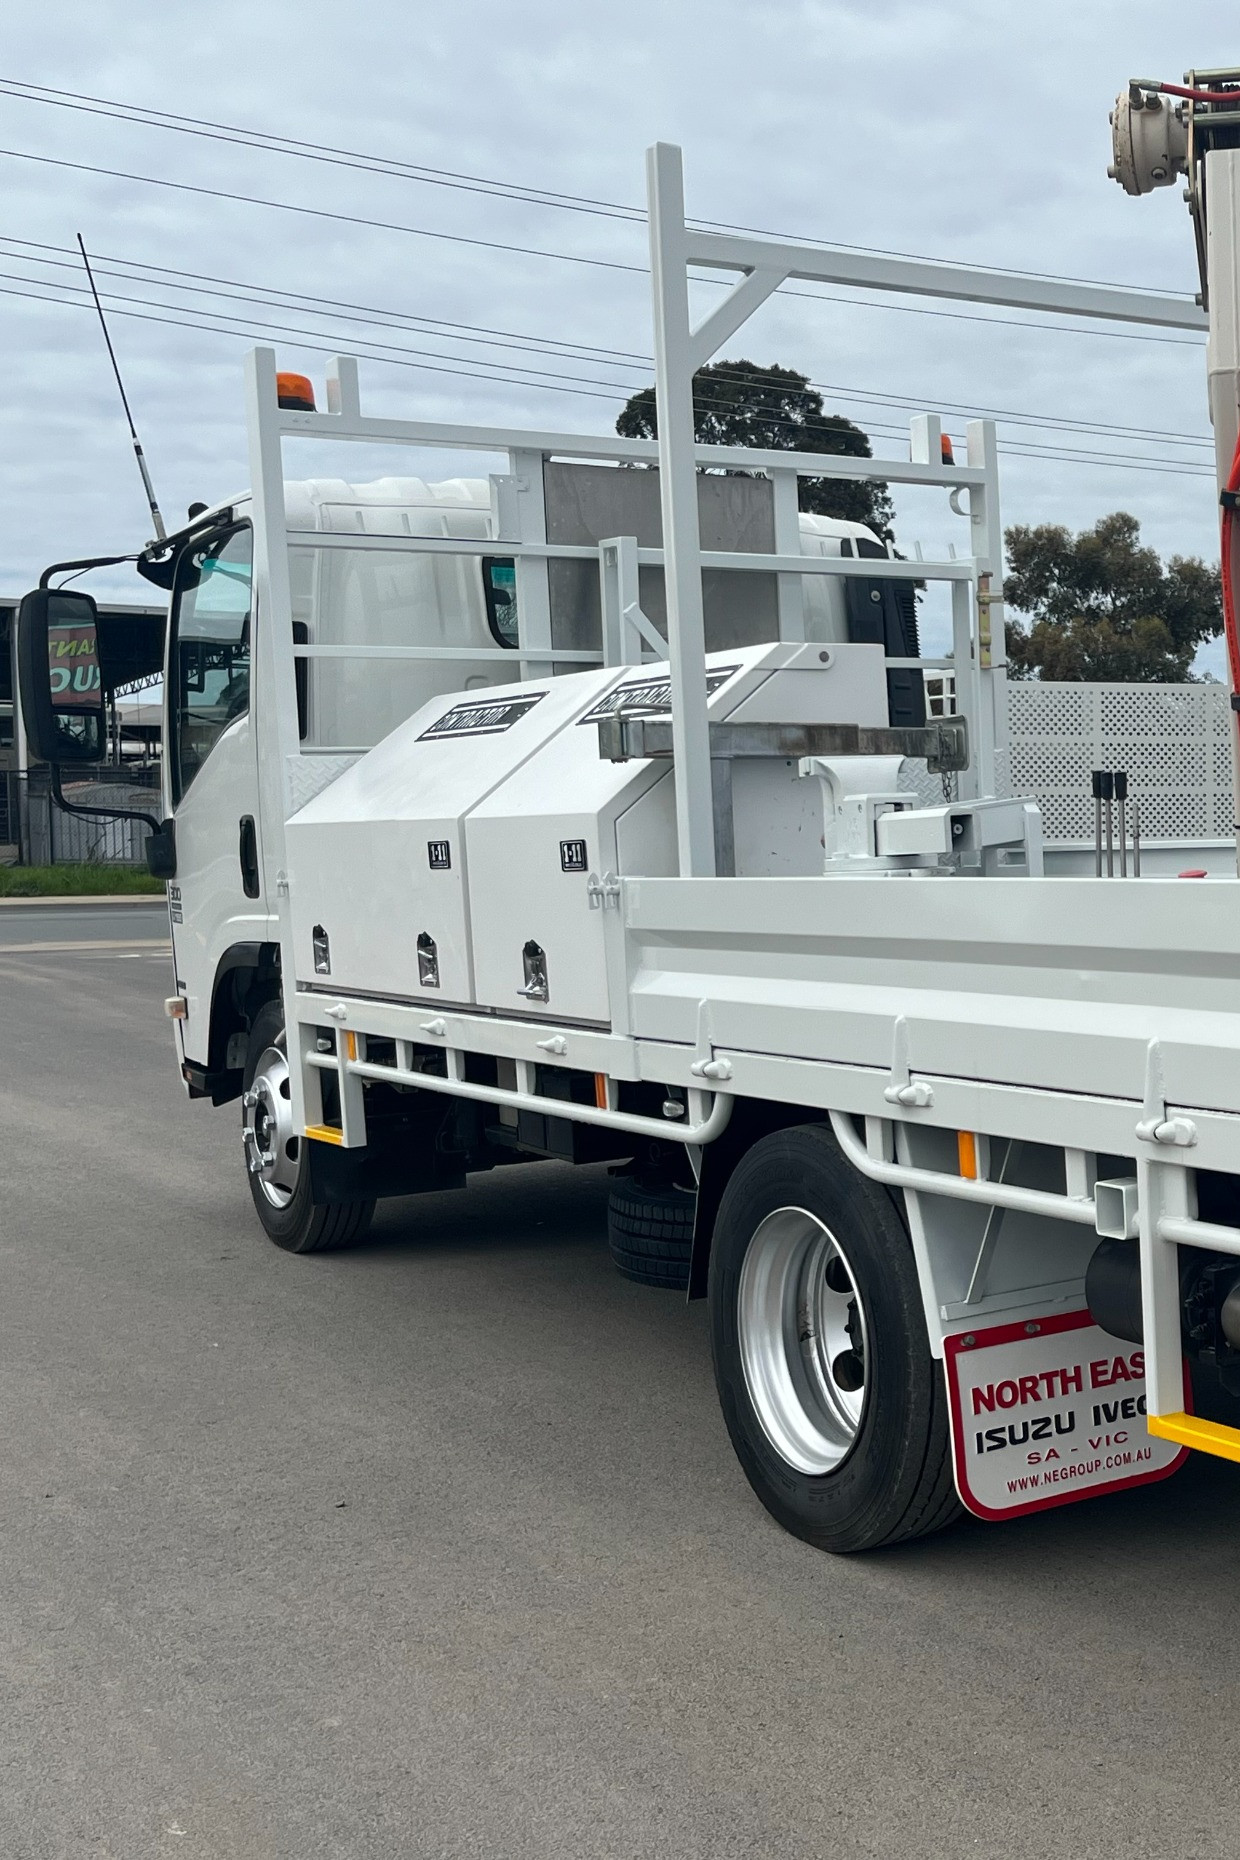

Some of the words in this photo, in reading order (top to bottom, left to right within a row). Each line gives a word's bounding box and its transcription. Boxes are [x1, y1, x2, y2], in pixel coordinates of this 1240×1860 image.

[429, 705, 513, 732] CONTRACTOR
[971, 1365, 1083, 1416] NORTH
[976, 1410, 1076, 1455] ISUZU
[1026, 1448, 1061, 1466] SA
[1088, 1430, 1129, 1450] VIC
[1006, 1446, 1152, 1494] WWW.NEGROUP.COM.AU
